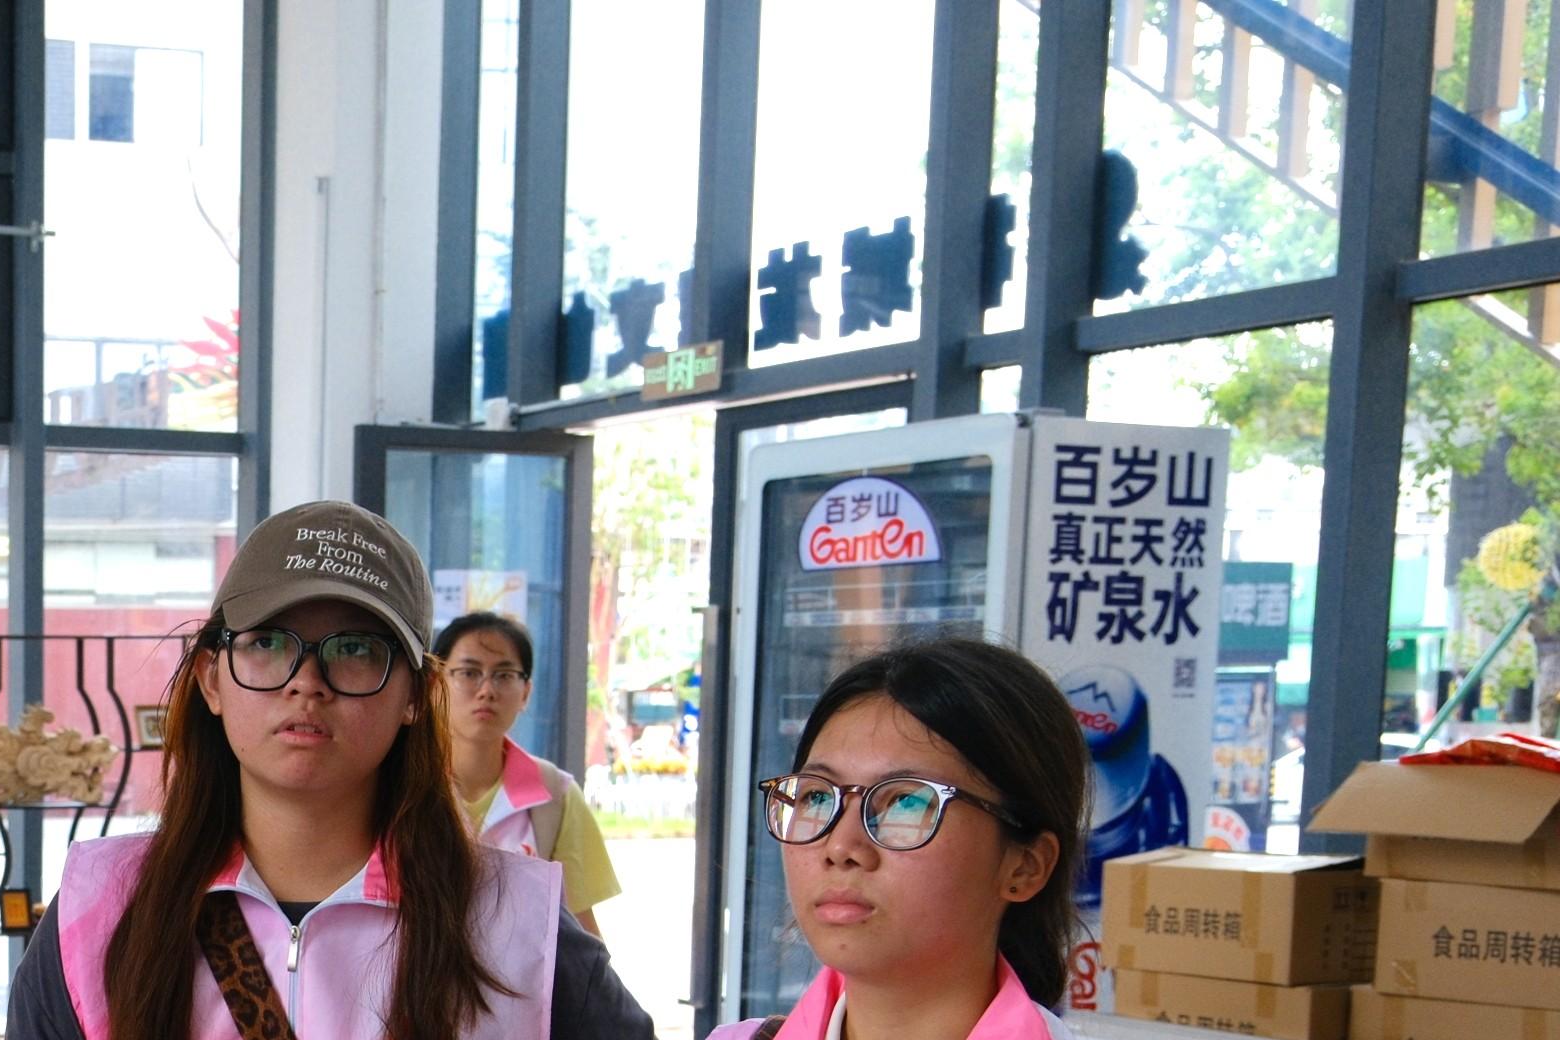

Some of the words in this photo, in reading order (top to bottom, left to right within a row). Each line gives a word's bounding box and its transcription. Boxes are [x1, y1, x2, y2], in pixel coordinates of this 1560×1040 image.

[1053, 443, 1214, 508] 百岁山
[825, 490, 900, 524] 百岁山
[295, 527, 349, 544] Break
[352, 531, 388, 559] Free
[316, 540, 364, 566] From
[1048, 511, 1207, 569] 真正天然
[284, 553, 316, 570] The
[318, 557, 390, 591] Routine
[1046, 569, 1201, 646] 矿泉水
[1143, 905, 1243, 942] 食品周转箱
[1431, 924, 1560, 969] 食品周转箱
